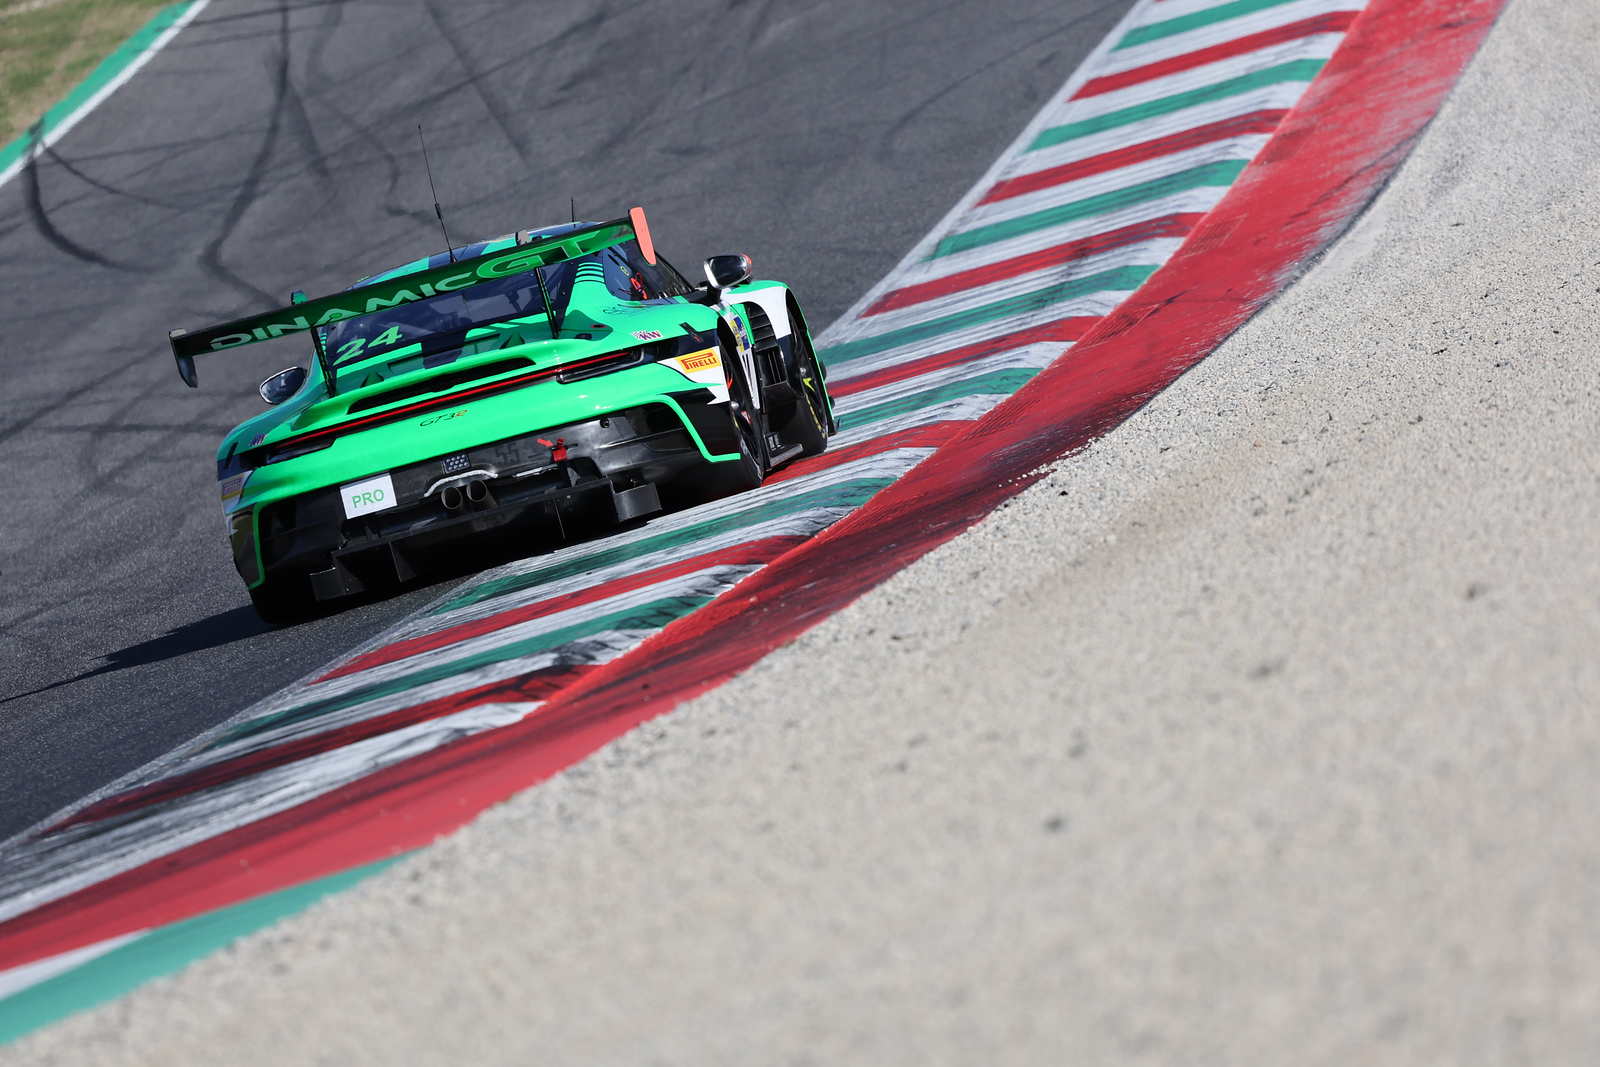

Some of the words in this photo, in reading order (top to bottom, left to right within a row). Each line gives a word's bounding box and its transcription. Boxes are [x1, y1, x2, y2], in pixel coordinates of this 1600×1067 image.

[332, 325, 403, 366] 24
[680, 352, 717, 370] PIRELLI
[352, 489, 385, 508] PRO
